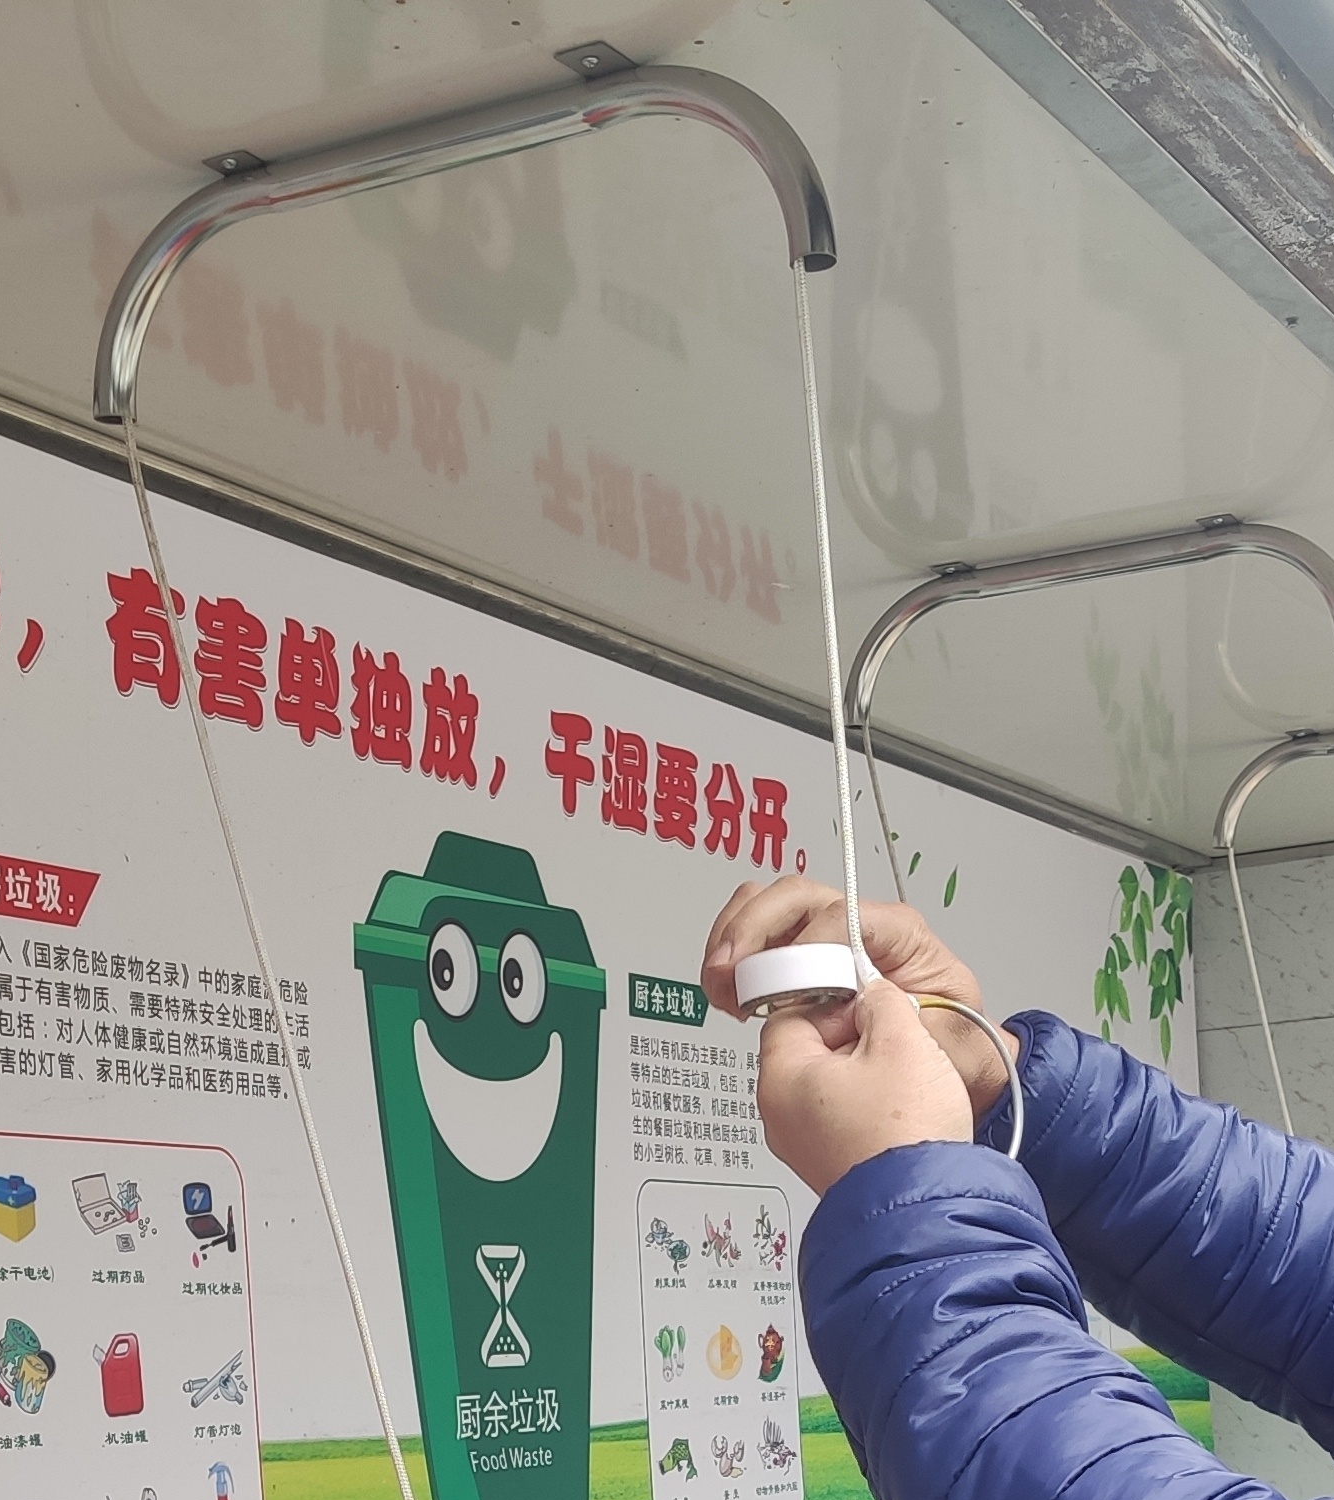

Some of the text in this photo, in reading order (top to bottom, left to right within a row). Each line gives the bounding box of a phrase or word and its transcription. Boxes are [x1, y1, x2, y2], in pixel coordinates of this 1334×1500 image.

[92, 1270, 146, 1284] 过期药品
[181, 1282, 244, 1296] 过期化妆品
[454, 1387, 562, 1441] 厨余垃圾
[105, 1430, 149, 1446] 机油罐
[194, 1423, 243, 1440] 灯管灯泡
[469, 1445, 554, 1473] Food Waste
